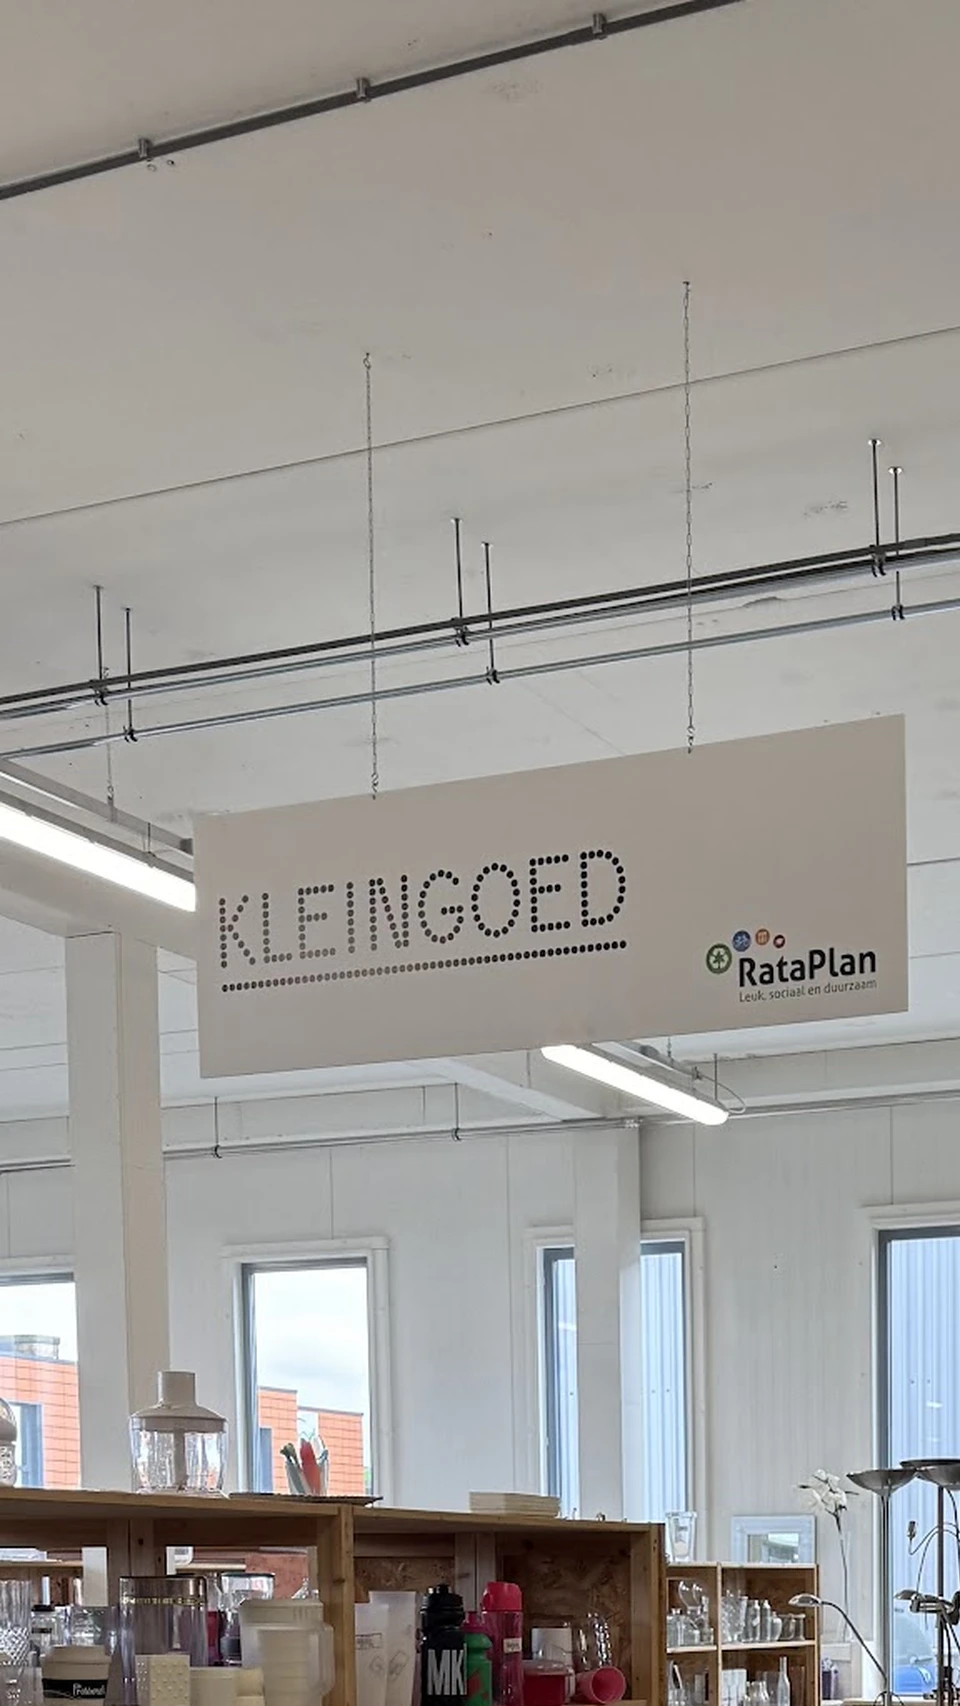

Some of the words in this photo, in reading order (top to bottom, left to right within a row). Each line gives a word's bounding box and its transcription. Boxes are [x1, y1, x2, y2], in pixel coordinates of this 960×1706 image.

[218, 849, 627, 969] KLEINGOED
[739, 947, 876, 987] RataPlan
[769, 986, 806, 999] sociaal
[808, 985, 821, 995] en
[823, 980, 878, 994] duurzaam
[427, 1649, 467, 1695] MK
